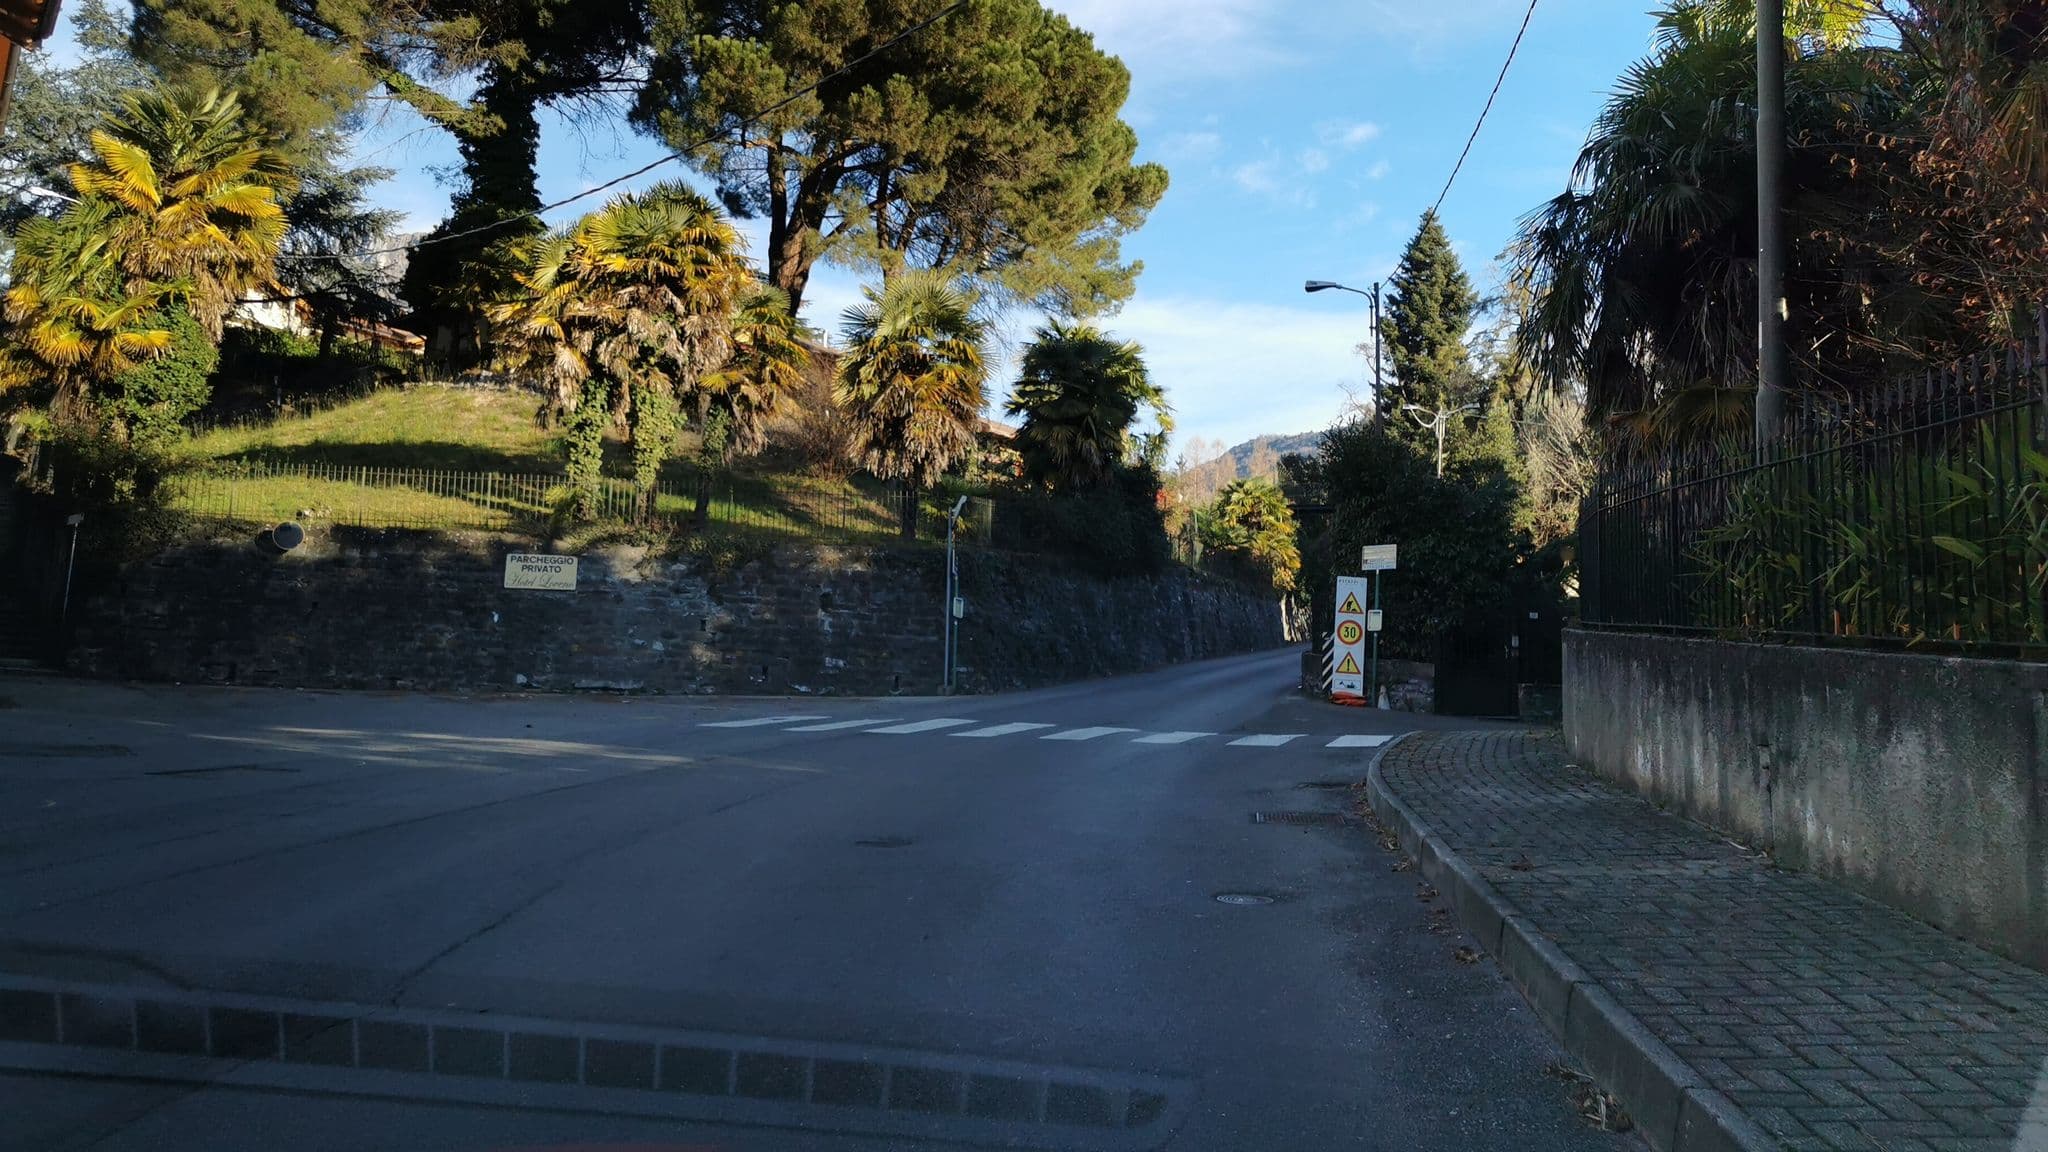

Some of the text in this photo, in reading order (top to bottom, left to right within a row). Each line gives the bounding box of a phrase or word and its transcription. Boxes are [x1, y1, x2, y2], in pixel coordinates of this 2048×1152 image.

[510, 555, 574, 565] PARCHEGGIO
[521, 564, 562, 574] PRIVATO
[511, 574, 536, 586] Hotel
[1343, 626, 1356, 639] 30
